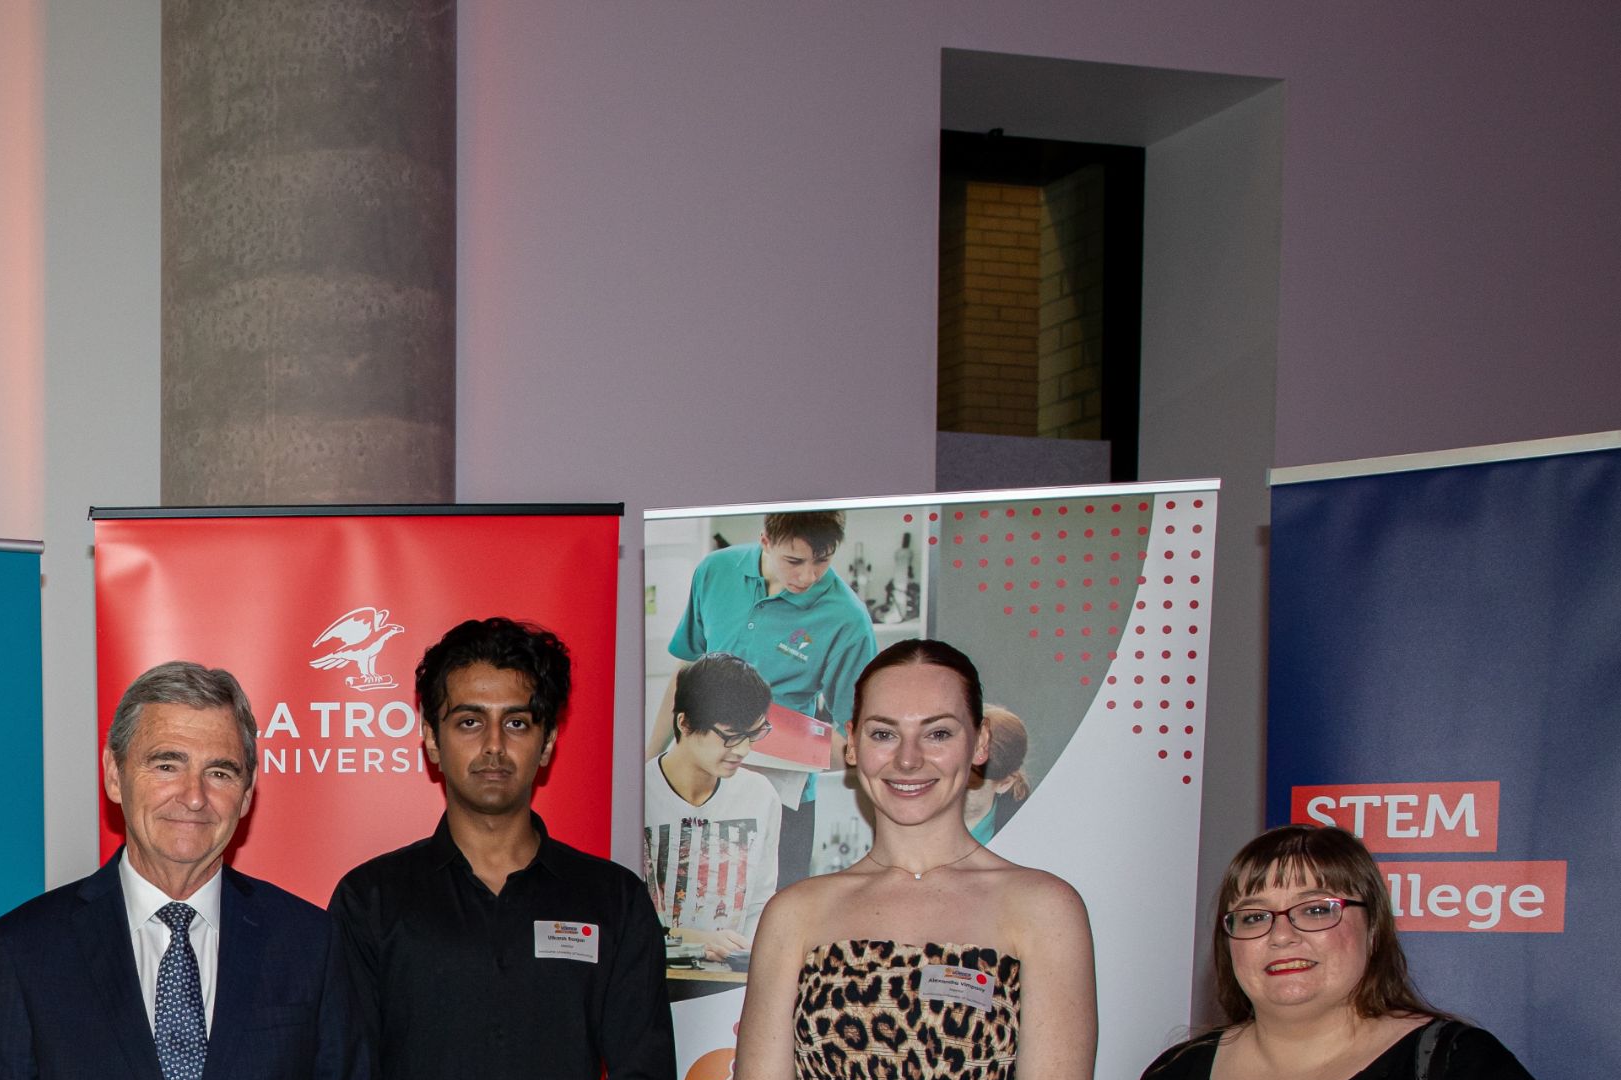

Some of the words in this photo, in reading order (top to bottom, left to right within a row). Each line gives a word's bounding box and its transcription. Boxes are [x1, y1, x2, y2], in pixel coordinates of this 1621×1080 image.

[256, 703, 301, 738] A
[310, 701, 423, 738] TRO
[1306, 793, 1480, 839] STEM
